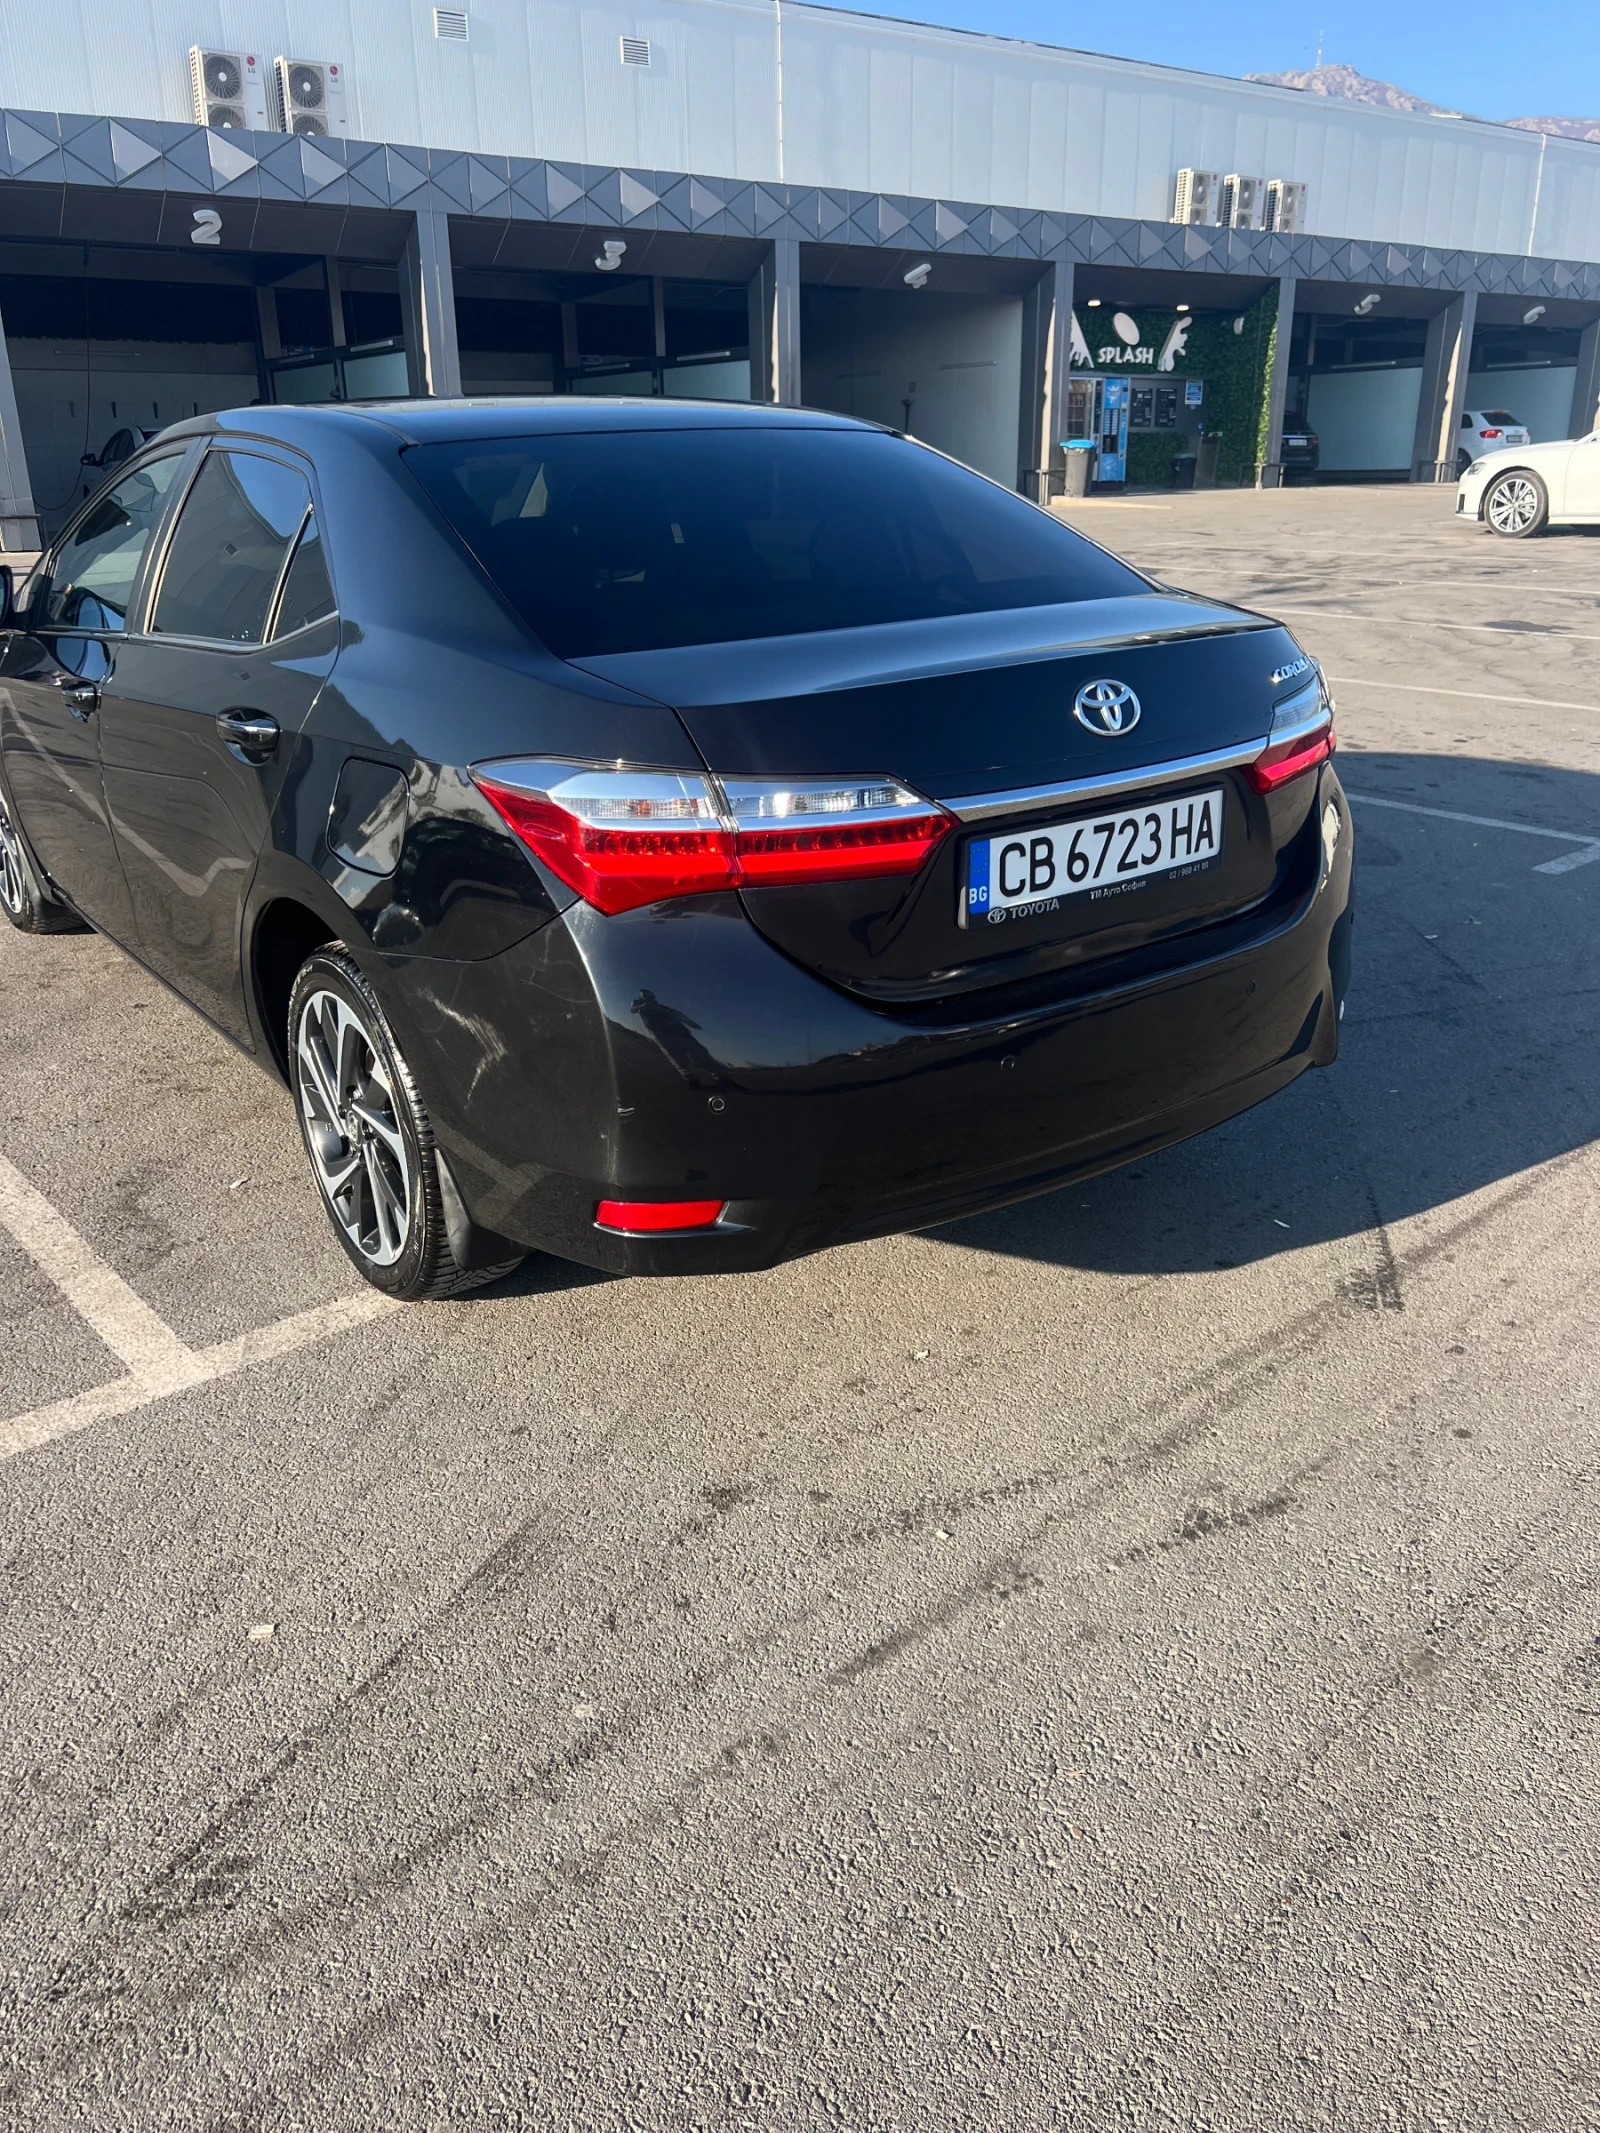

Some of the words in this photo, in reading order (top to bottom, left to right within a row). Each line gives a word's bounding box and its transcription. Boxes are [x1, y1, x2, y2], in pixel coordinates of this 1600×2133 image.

[191, 209, 222, 245] 2
[595, 240, 627, 270] 3
[1098, 346, 1154, 364] SPLASH
[1271, 656, 1309, 684] COROLL
[999, 836, 1056, 898] CB
[1066, 812, 1162, 883] 6723
[1170, 800, 1215, 860] HA
[969, 885, 988, 905] BG
[1122, 880, 1147, 892] София
[1010, 898, 1060, 919] TOYOTA
